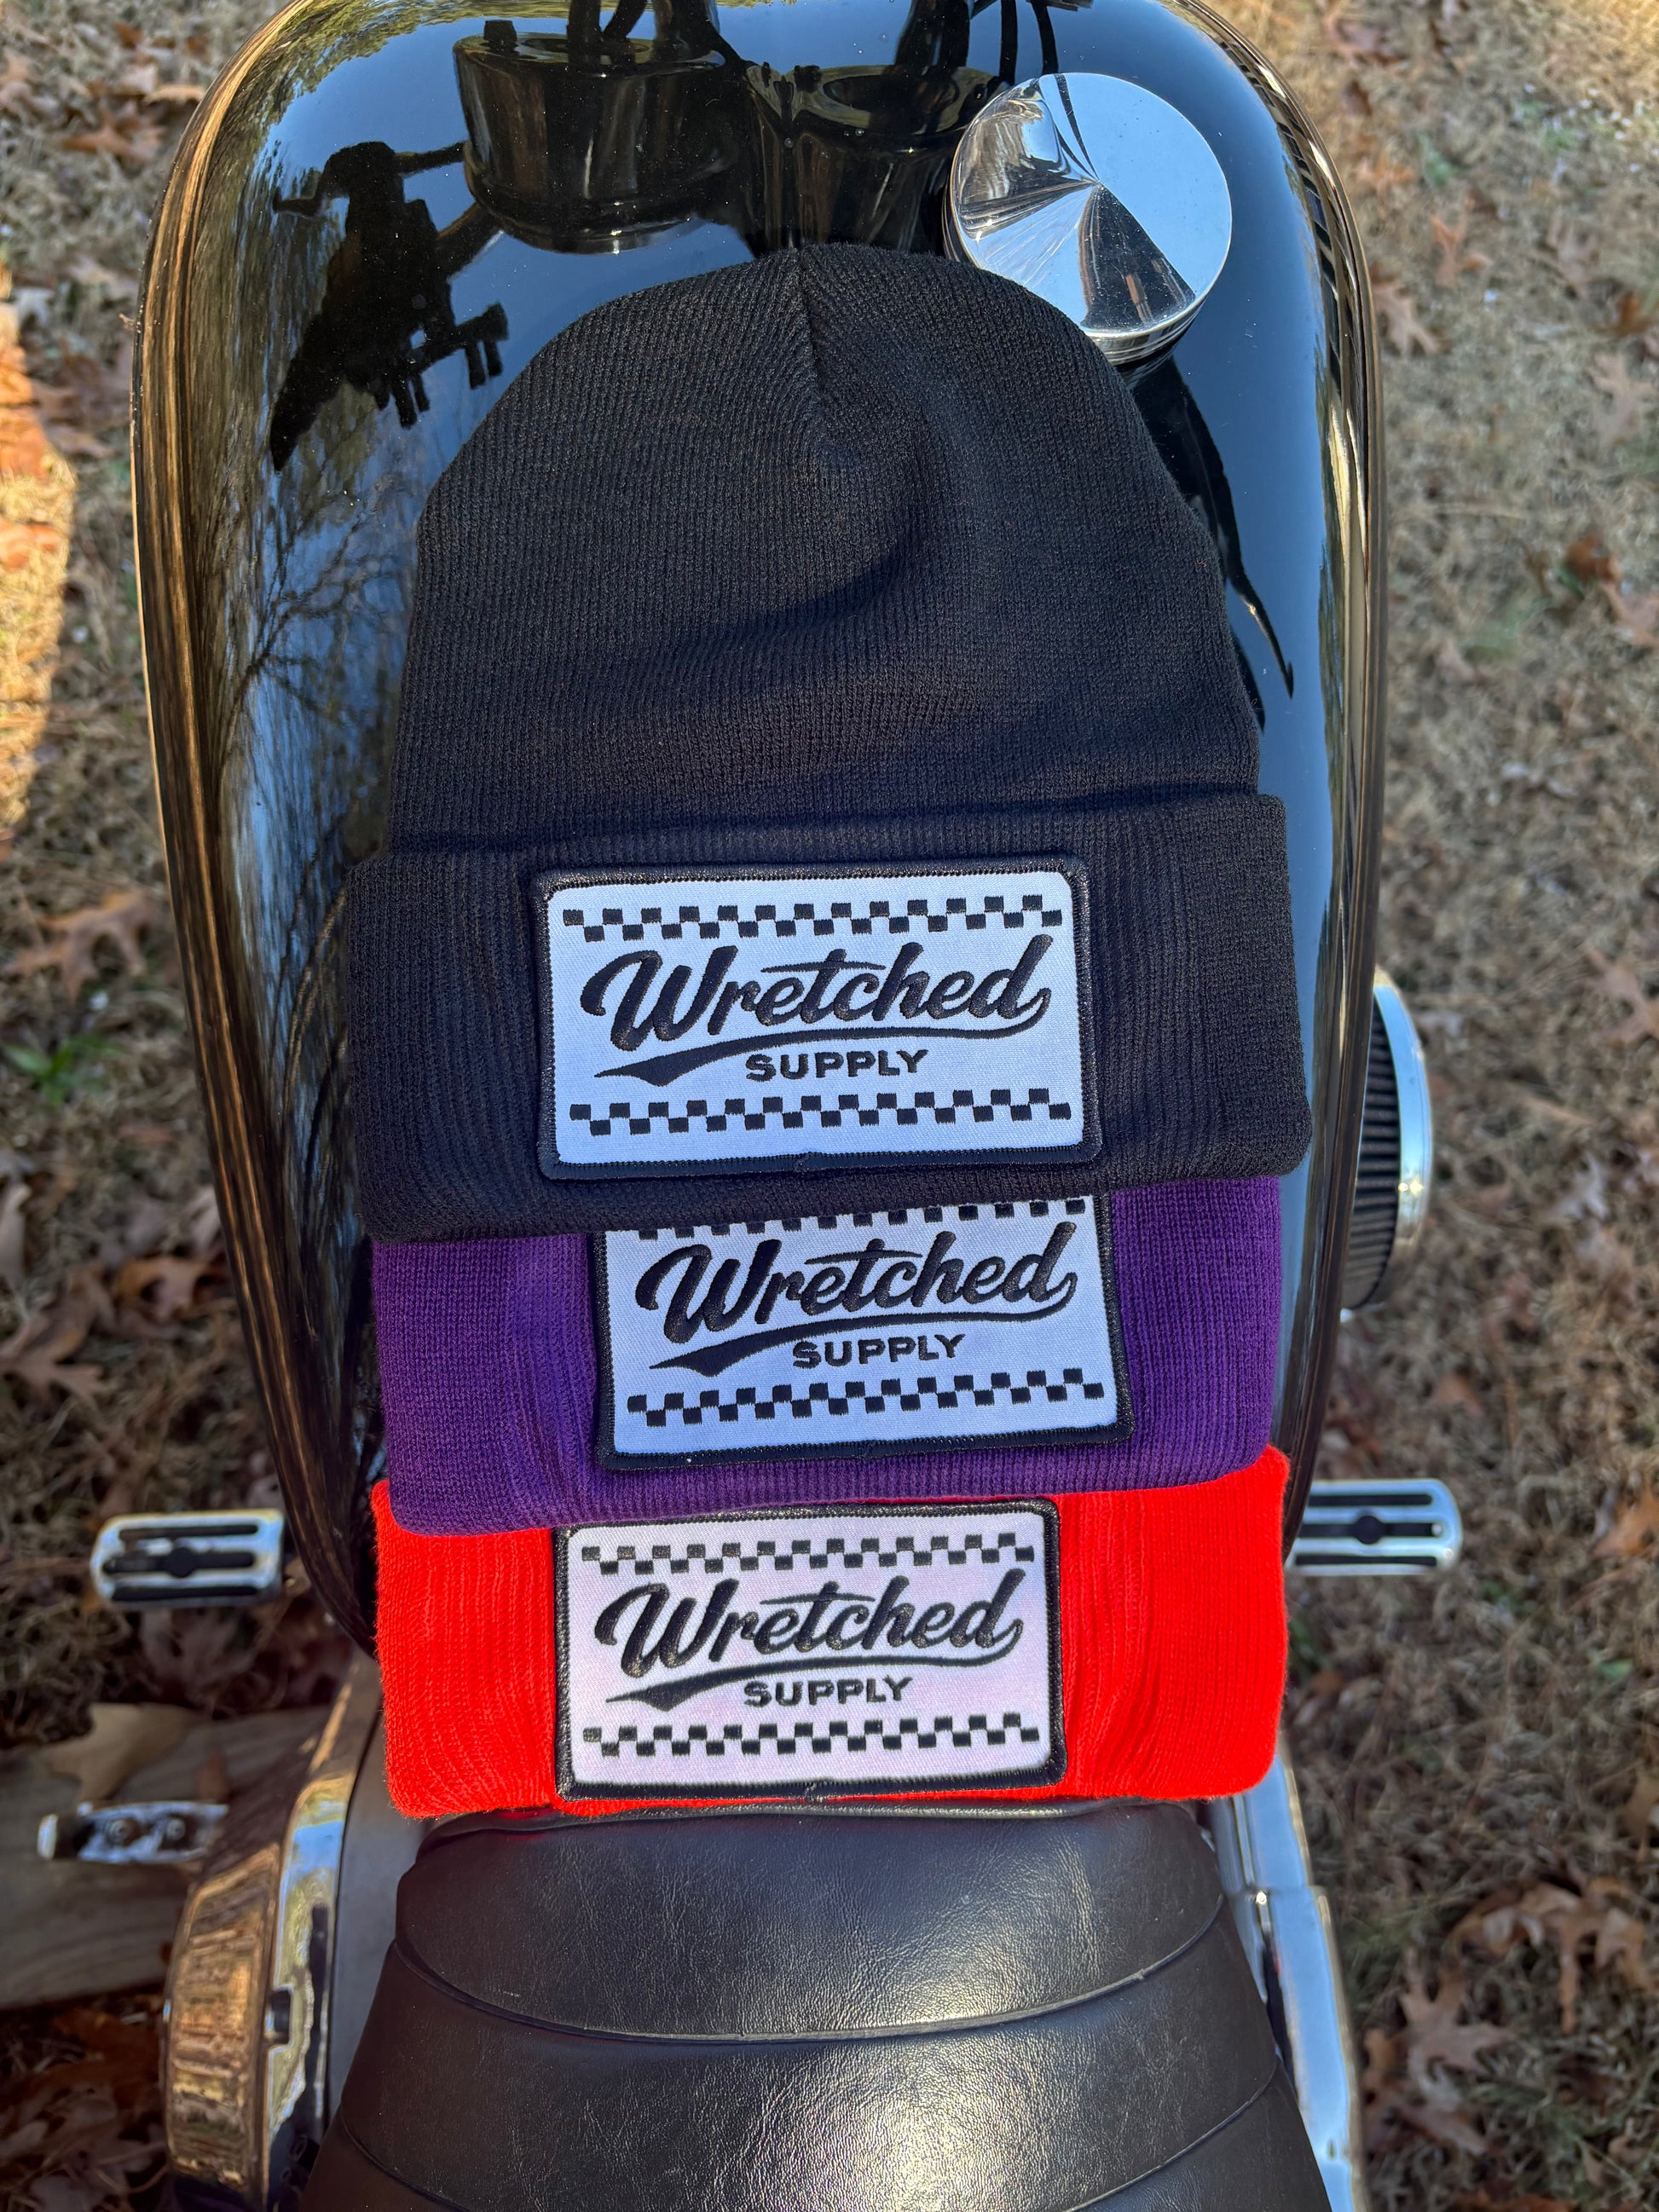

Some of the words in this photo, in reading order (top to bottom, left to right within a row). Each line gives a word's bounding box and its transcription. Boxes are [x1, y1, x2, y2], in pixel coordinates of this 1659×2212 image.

[581, 934, 1054, 1051] Wretched
[745, 1048, 928, 1083] SUPPLY
[634, 1222, 1077, 1343] Wretched
[792, 1333, 966, 1369] SUPPLY
[595, 1568, 1026, 1678] Wretched
[743, 1674, 913, 1707] SUPPLY
